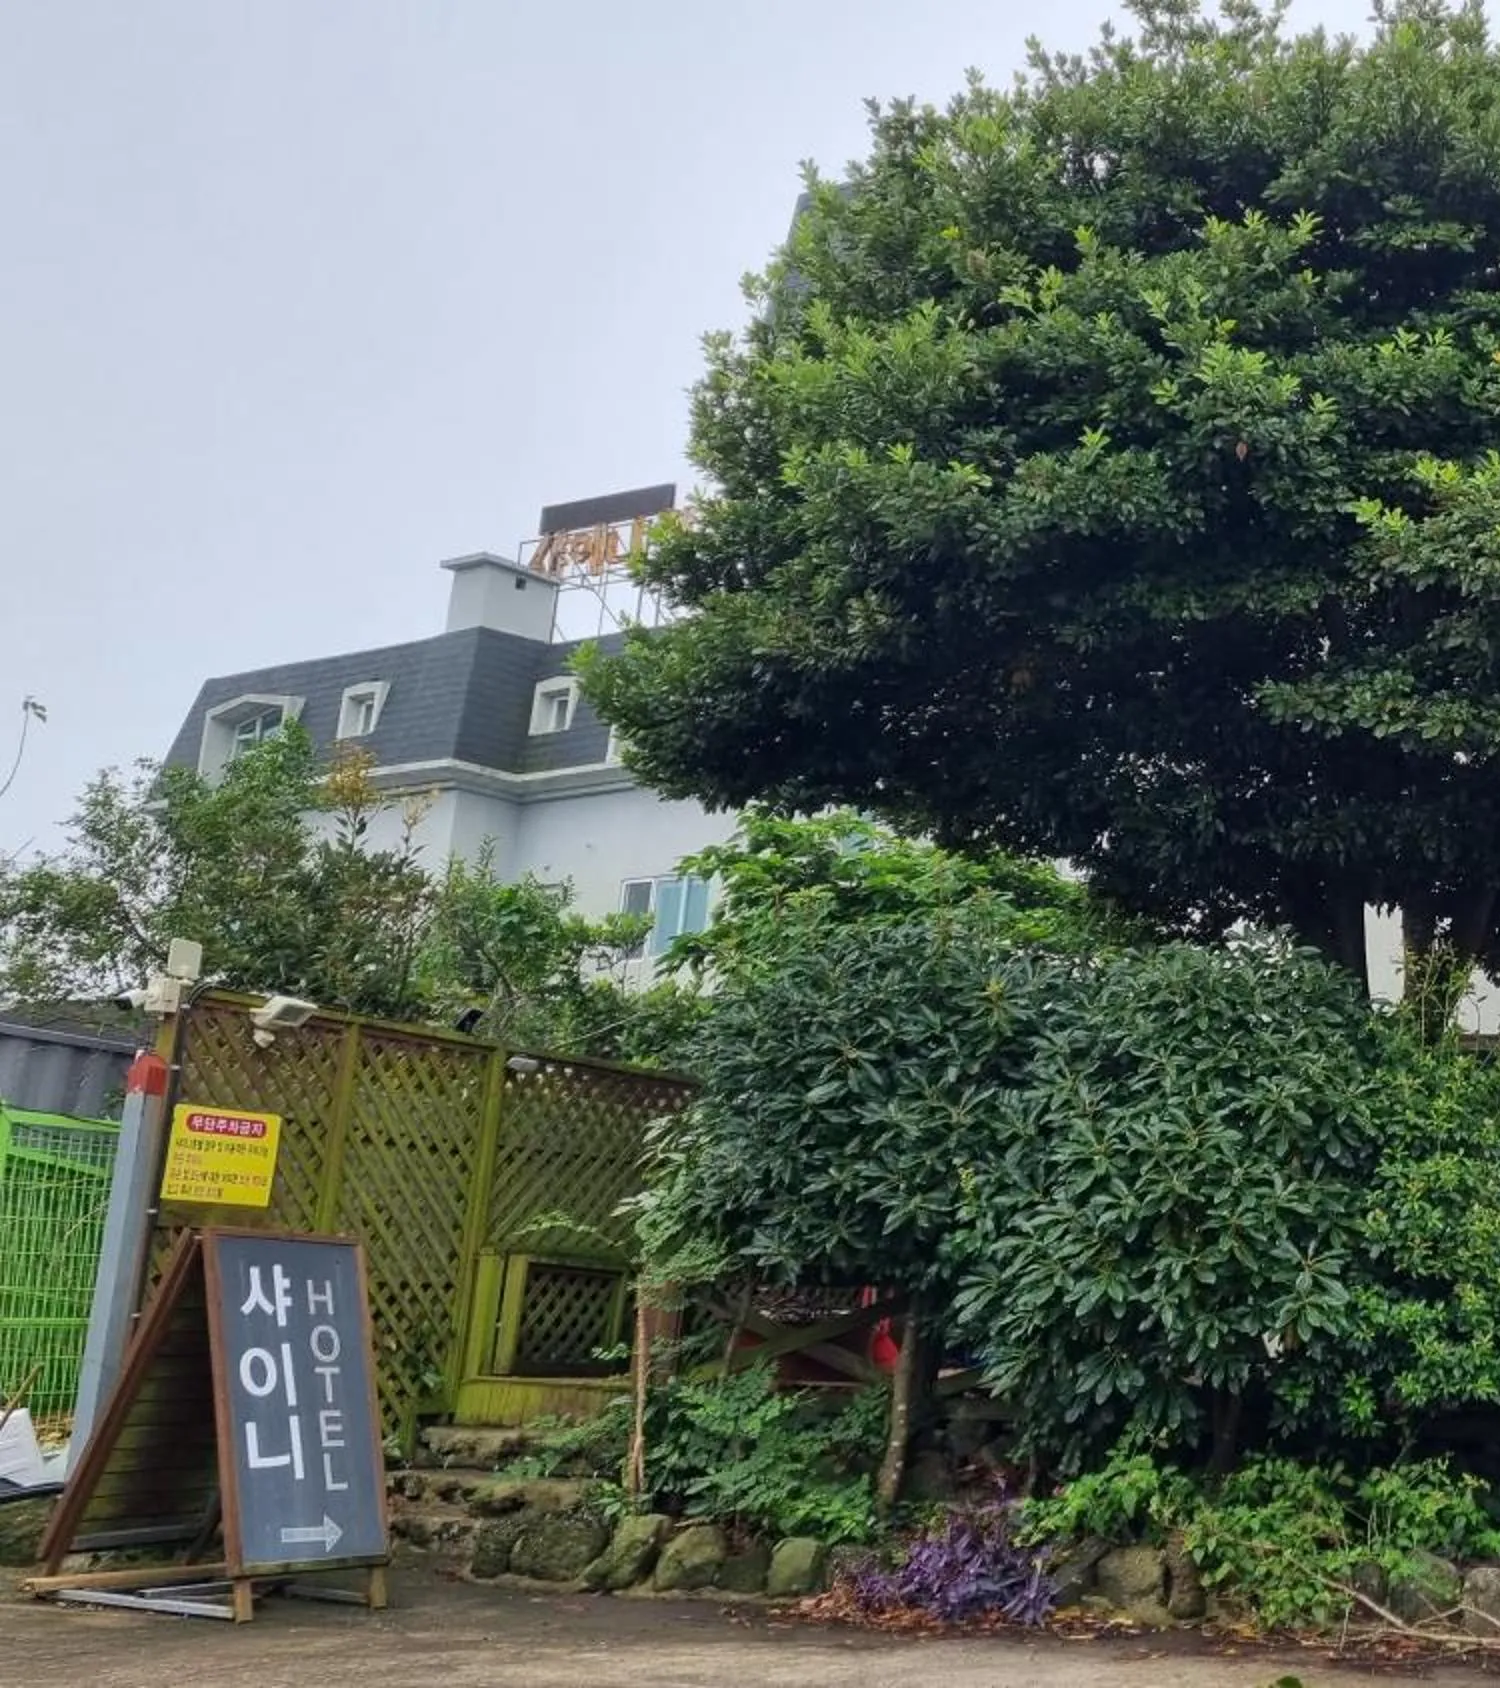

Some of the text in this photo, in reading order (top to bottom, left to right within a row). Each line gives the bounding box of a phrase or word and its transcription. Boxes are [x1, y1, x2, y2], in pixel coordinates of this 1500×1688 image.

[191, 1115, 264, 1137] 무단주차금지
[239, 1263, 305, 1481] 샤이니
[306, 1279, 349, 1491] HOTEL
